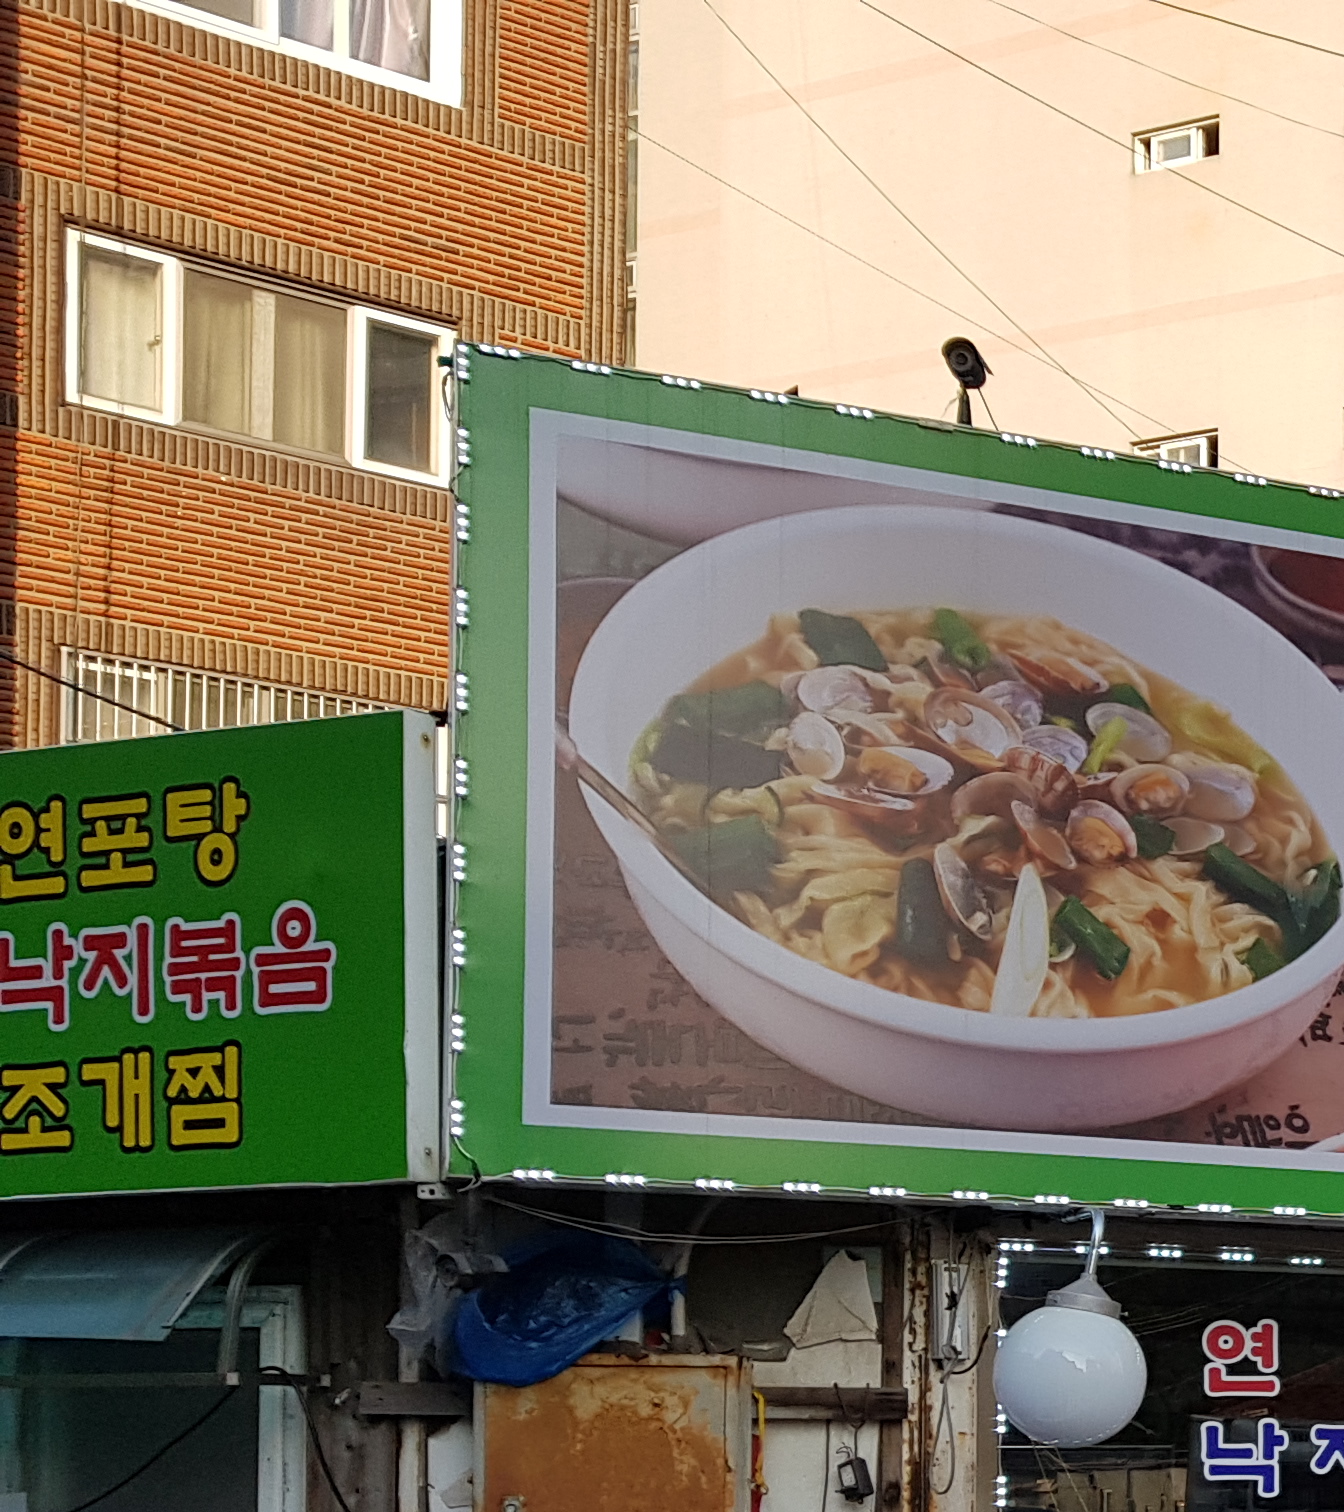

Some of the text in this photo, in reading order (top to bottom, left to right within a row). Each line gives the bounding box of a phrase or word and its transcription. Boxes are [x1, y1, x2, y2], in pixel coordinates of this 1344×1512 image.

[0, 775, 250, 904] 연포탕
[0, 900, 337, 1032] 낙지볶음
[0, 1039, 243, 1155] 조개찜
